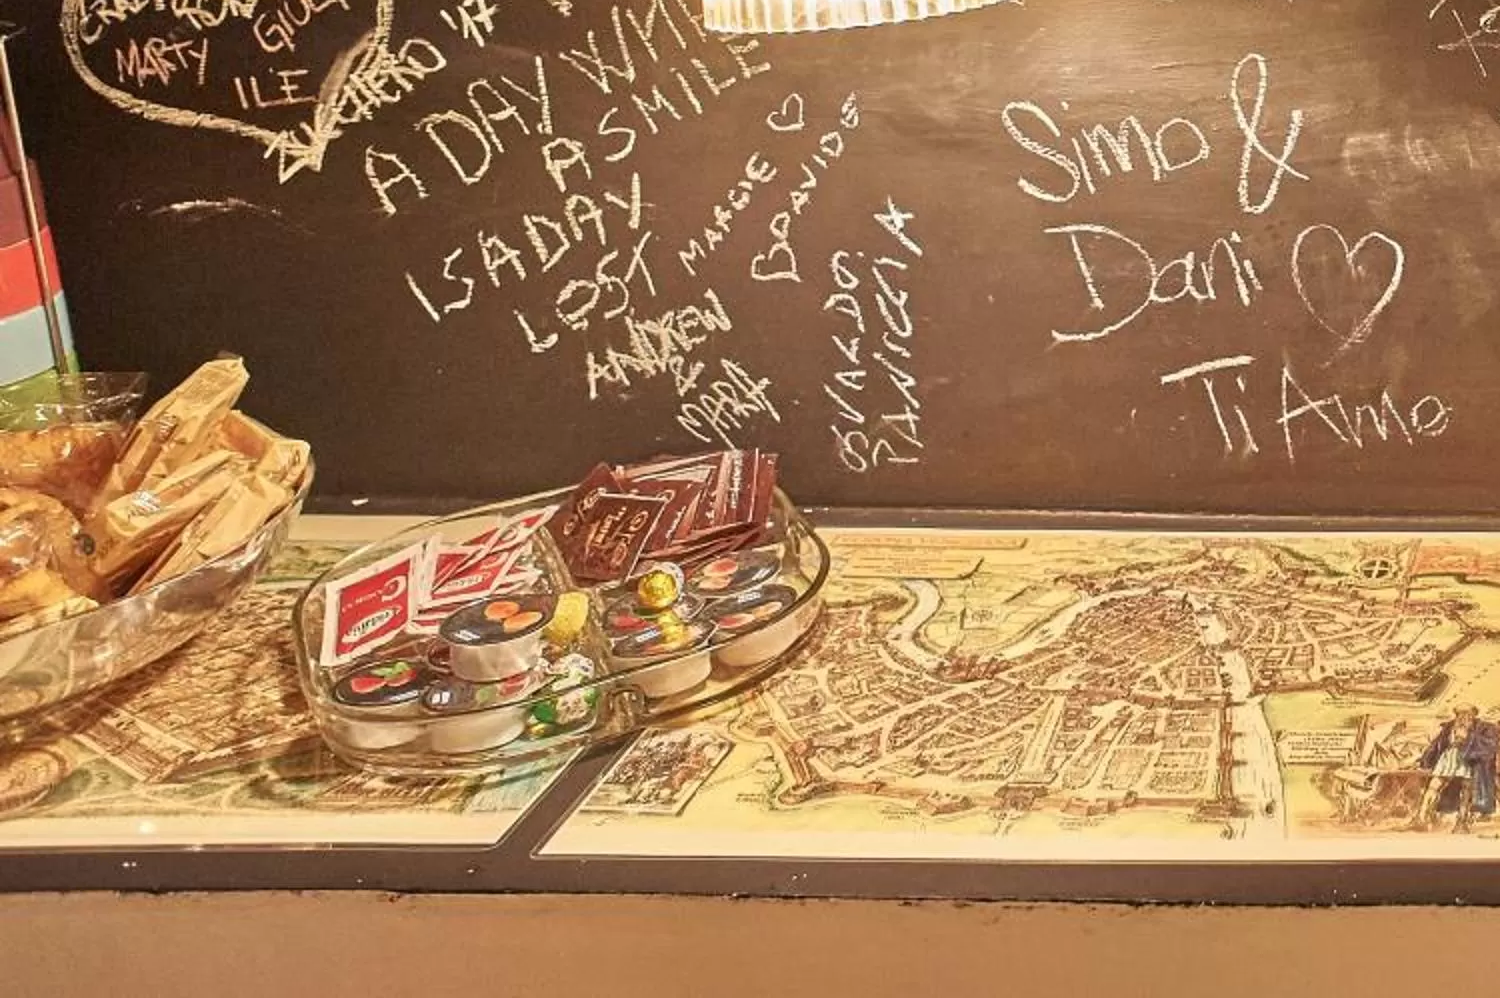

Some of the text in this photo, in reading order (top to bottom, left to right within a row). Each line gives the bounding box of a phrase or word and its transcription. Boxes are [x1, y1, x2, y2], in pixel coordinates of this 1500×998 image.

[115, 37, 209, 88] MARTY
[541, 36, 771, 193] A SMILE
[364, 145, 429, 218] A
[414, 54, 555, 186] DAY
[1229, 51, 1311, 216] &
[523, 171, 643, 274] DAY
[1042, 223, 1266, 344] Dani
[512, 231, 657, 354] LOST
